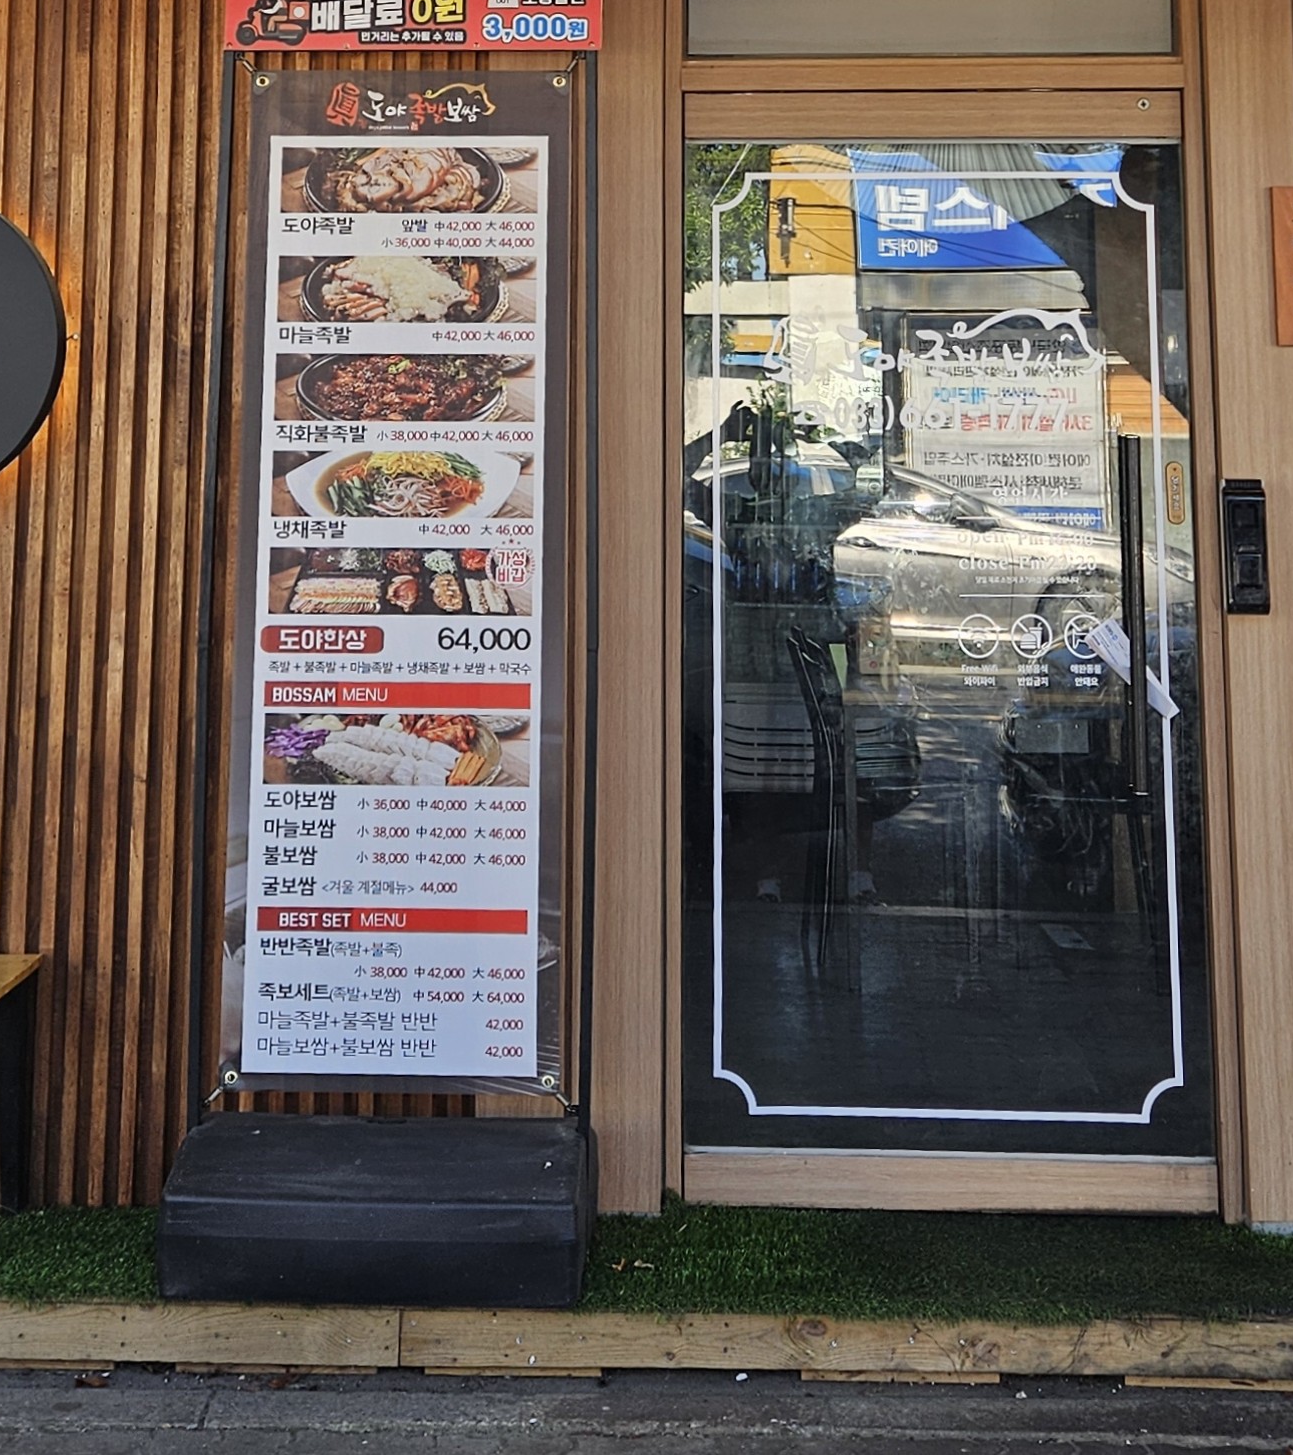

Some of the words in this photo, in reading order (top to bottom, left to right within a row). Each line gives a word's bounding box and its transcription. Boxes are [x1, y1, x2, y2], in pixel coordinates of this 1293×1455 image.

[433, 32, 441, 42] 수
[445, 31, 464, 42] 있음
[485, 16, 586, 41] 3,000원
[282, 216, 354, 235] 도야족발
[402, 219, 427, 232] 앞발
[446, 221, 481, 233] 42,000
[499, 221, 535, 233] 46,000
[395, 237, 430, 249] 36,000
[446, 237, 481, 249] 40,000
[499, 237, 535, 249] 44,000
[279, 326, 351, 344] 마늘족발
[445, 331, 481, 342] 42,000
[497, 331, 535, 343] 46,000
[276, 425, 367, 442] 직화불족발
[391, 431, 427, 442] 38,000
[442, 431, 479, 442] 42,000
[495, 431, 533, 442] 46,000
[993, 486, 1068, 504] 영업시간
[274, 521, 346, 539] 냉채족발
[432, 525, 470, 536] 42,000
[496, 525, 533, 536] 46,000
[497, 552, 525, 565] 가성
[498, 568, 525, 582] 비갑
[279, 629, 366, 650] 도야한상
[438, 628, 531, 653] 64,000
[269, 661, 290, 673] 족발
[304, 661, 336, 673] 불족발
[350, 662, 393, 674] 마늘족발
[407, 662, 449, 674] 냉채족발
[464, 663, 485, 675] 보쌈
[499, 664, 531, 675] 막국수
[272, 688, 336, 702] BOSSAM
[342, 688, 388, 702] MENU
[264, 791, 336, 810] 도야보쌈
[373, 799, 410, 811] 36,000
[430, 800, 467, 811] 40,000
[489, 800, 526, 812] 44,000
[264, 819, 335, 838] 마늘보쌈
[372, 827, 409, 839] 38,000
[429, 828, 466, 839] 42,000
[489, 828, 526, 840] 46,000
[263, 846, 317, 866] 불보쌈
[372, 853, 409, 865] 38,000
[428, 854, 466, 865] 42,000
[488, 854, 526, 866] 46,000
[262, 876, 316, 896] 굴보쌈
[322, 881, 354, 894] <겨울
[358, 881, 414, 894] 계절메뉴>
[420, 882, 457, 894] 44,000
[279, 912, 318, 927] BEST
[322, 913, 351, 928] SET
[360, 914, 406, 927] MENU
[260, 938, 402, 957] 반반족발(족발+불족)
[370, 967, 407, 979] 38,000
[428, 967, 465, 979] 42,000
[487, 968, 525, 980] 46,000
[258, 983, 401, 1003] 족보세트(족발+보쌈)
[427, 991, 464, 1003] 54,000
[487, 991, 524, 1004] 64,000
[258, 1011, 395, 1030] 마늘족발+불족발
[401, 1013, 437, 1031] 반반
[485, 1019, 523, 1031] 42,000
[257, 1038, 395, 1058] 마늘보쌈+불보쌈
[400, 1040, 437, 1058] 반반
[485, 1046, 523, 1058] 42,000
